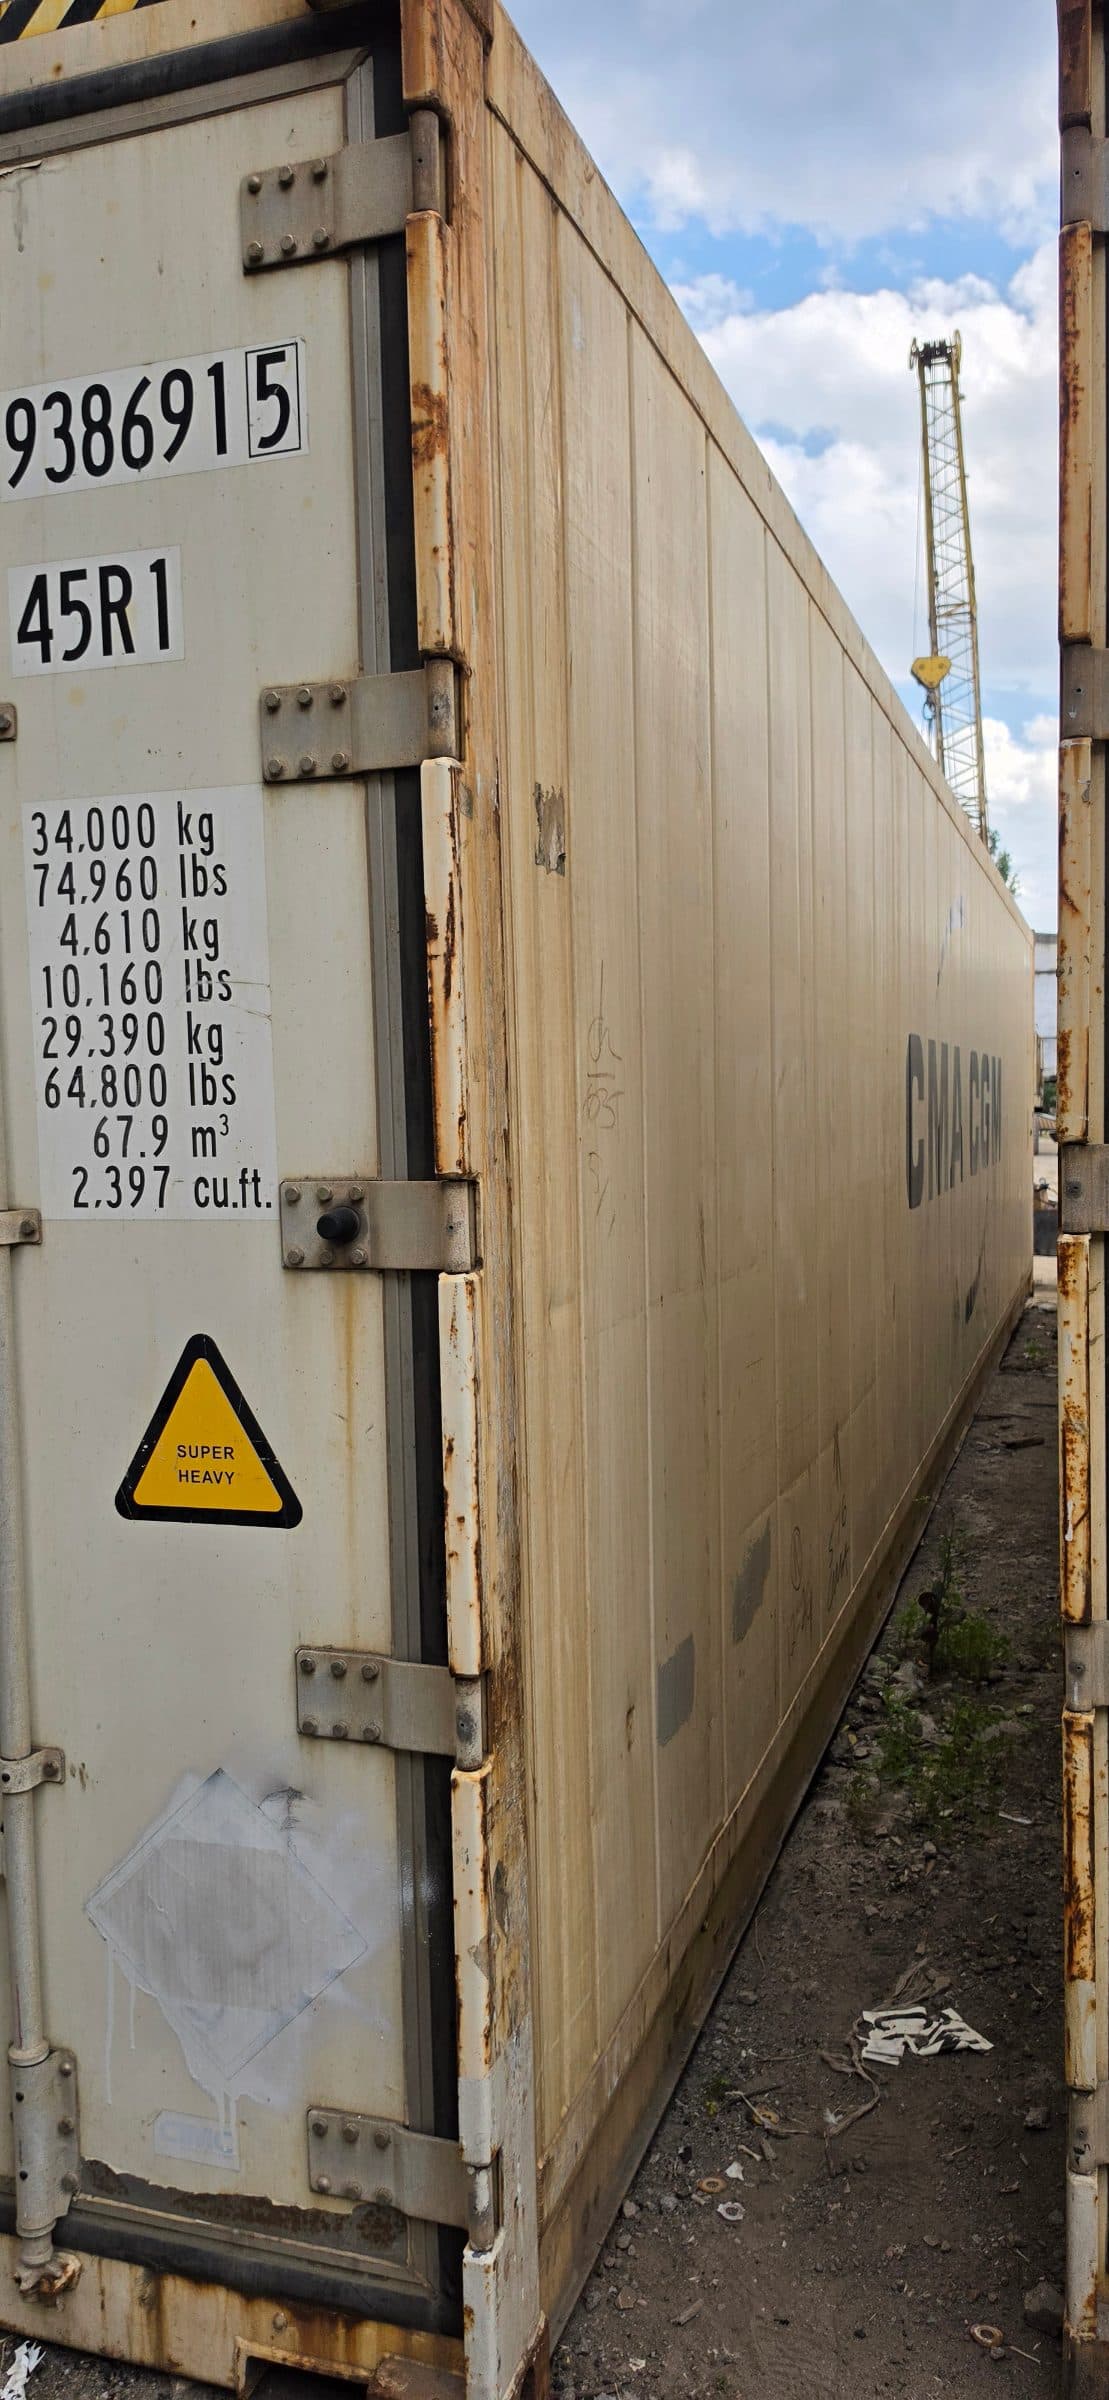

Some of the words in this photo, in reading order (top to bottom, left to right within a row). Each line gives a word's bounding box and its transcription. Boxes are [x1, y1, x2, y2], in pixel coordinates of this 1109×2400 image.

[17, 558, 170, 664] 45R1
[31, 803, 156, 856] 34,000
[177, 801, 214, 856] kg
[33, 856, 158, 907] 74,960
[179, 853, 229, 899] lbs
[60, 908, 160, 957] 4,610
[182, 907, 219, 962] kg
[42, 960, 164, 1009] 10,160
[184, 958, 233, 1003] lbs
[41, 1011, 165, 1059] 29,390
[186, 1011, 224, 1066] kg
[44, 1063, 167, 1109] 64,800
[188, 1062, 237, 1107] lbs
[93, 1114, 169, 1158] 67.9
[191, 1113, 230, 1158] m³
[907, 1034, 963, 1209] CMA
[970, 1051, 1001, 1176] CGM
[71, 1165, 171, 1210] 2,397
[194, 1168, 273, 1210] cu.ft.
[177, 1444, 234, 1460] SUPER
[178, 1469, 235, 1485] HEAVY
